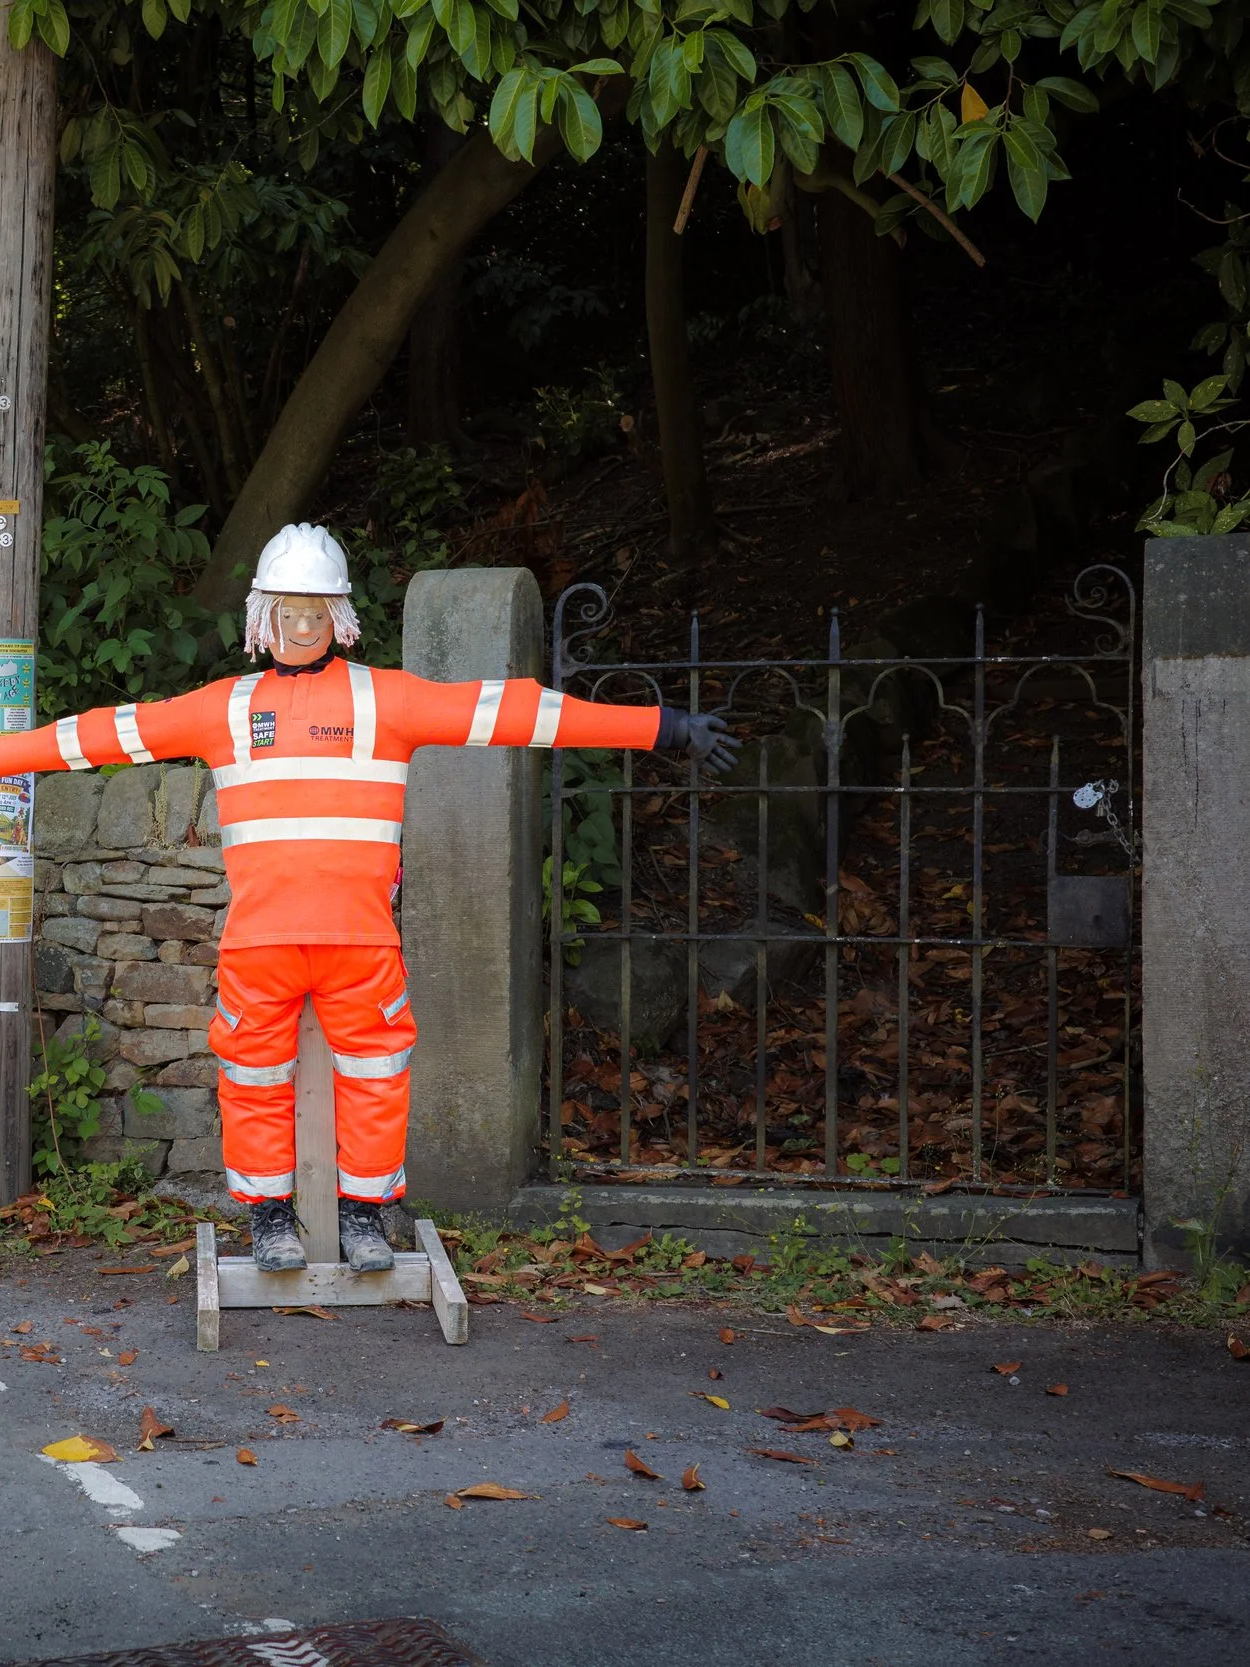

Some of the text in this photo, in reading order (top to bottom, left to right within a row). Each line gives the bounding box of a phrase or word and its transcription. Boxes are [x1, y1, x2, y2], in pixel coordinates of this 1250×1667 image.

[253, 731, 275, 740] SAFE
[320, 726, 355, 736] MWH
[253, 738, 274, 747] START
[1, 776, 13, 784] FUN
[13, 778, 24, 787] DAY
